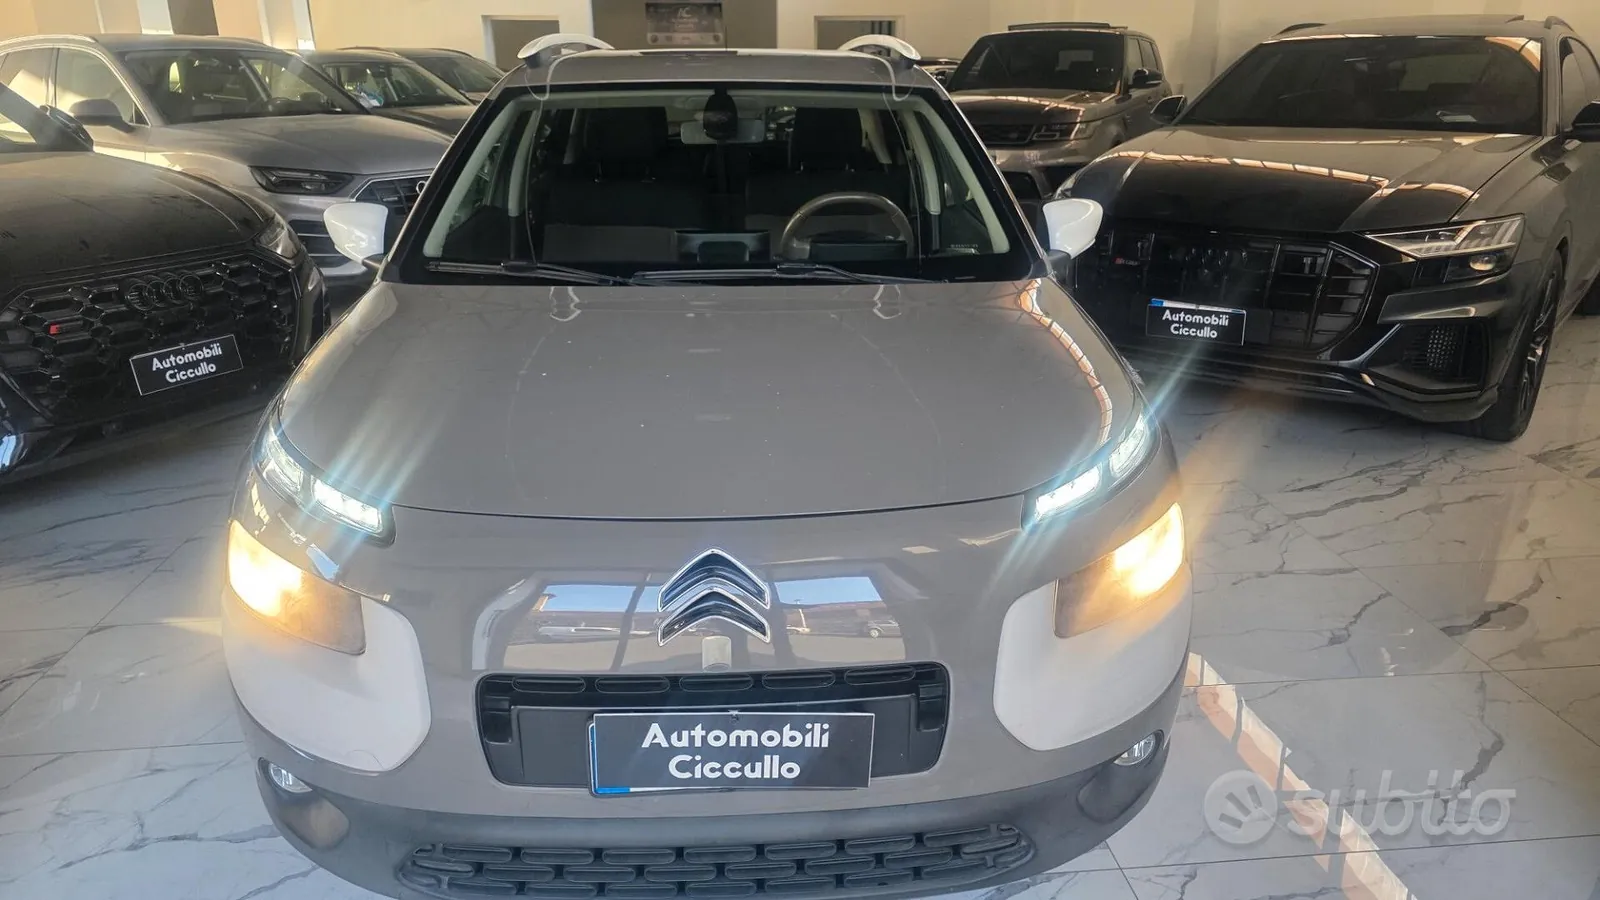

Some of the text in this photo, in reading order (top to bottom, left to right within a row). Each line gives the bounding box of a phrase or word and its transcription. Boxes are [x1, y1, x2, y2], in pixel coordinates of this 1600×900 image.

[1162, 309, 1229, 326] Automobili
[1170, 323, 1218, 339] Ciccullo
[151, 343, 222, 371] Automobili
[165, 361, 216, 383] Ciccullo
[641, 723, 829, 748] Automobili
[668, 754, 801, 779] Ciccullo
